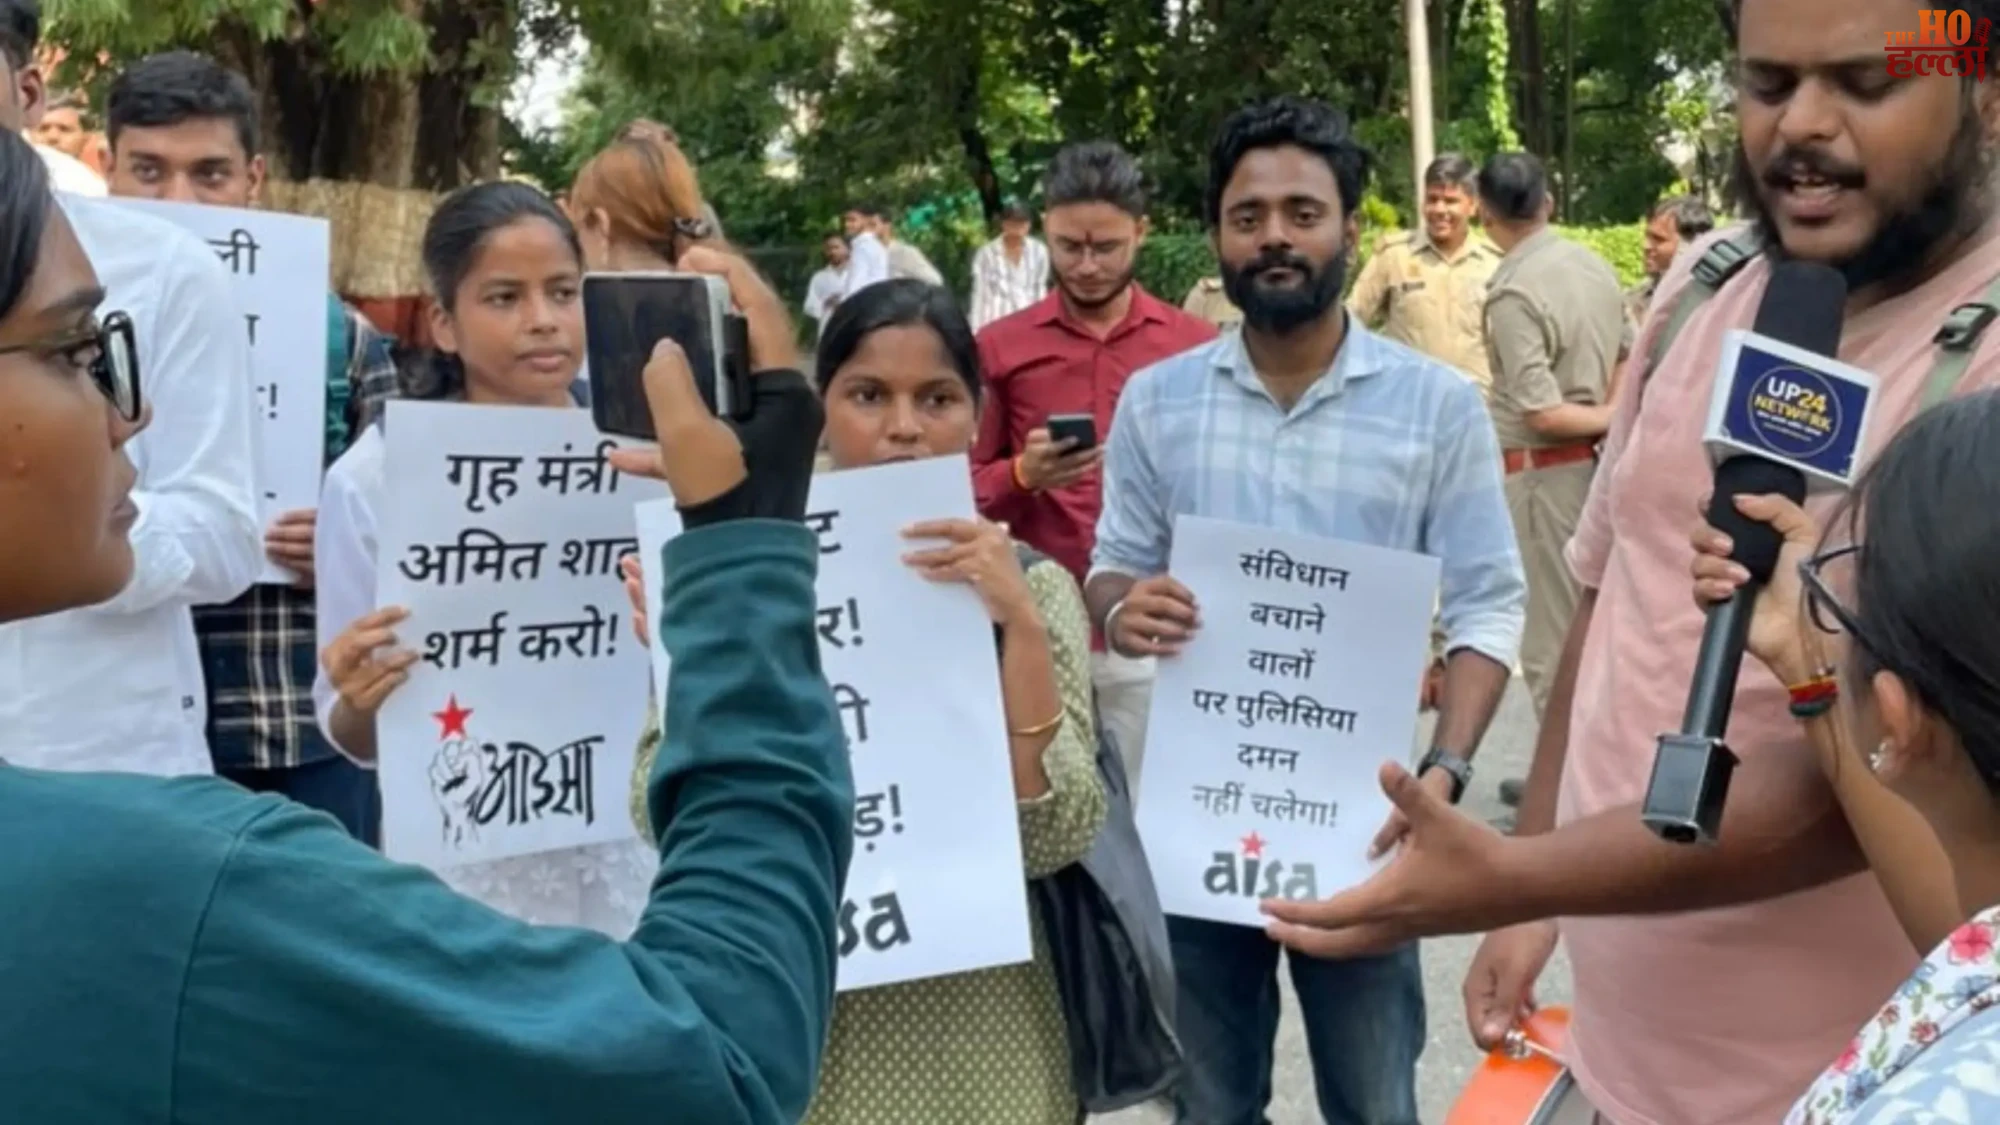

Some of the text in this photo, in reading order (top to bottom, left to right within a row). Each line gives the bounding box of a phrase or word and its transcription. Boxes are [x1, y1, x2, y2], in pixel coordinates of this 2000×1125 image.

[1767, 376, 1828, 413] UP24
[446, 440, 619, 512] गृह मंत्री
[398, 528, 548, 585] अमित
[1239, 549, 1350, 591] संविधान
[421, 604, 618, 668] शर्म करो!
[1250, 602, 1325, 634] बचाने
[1248, 648, 1316, 680] वालों
[1193, 689, 1358, 733] पर पुलिसिया
[1237, 742, 1299, 773] दमन
[1192, 781, 1338, 828] नहीं चलेगा!
[1203, 843, 1318, 901] aisa
[838, 891, 911, 958] sa
